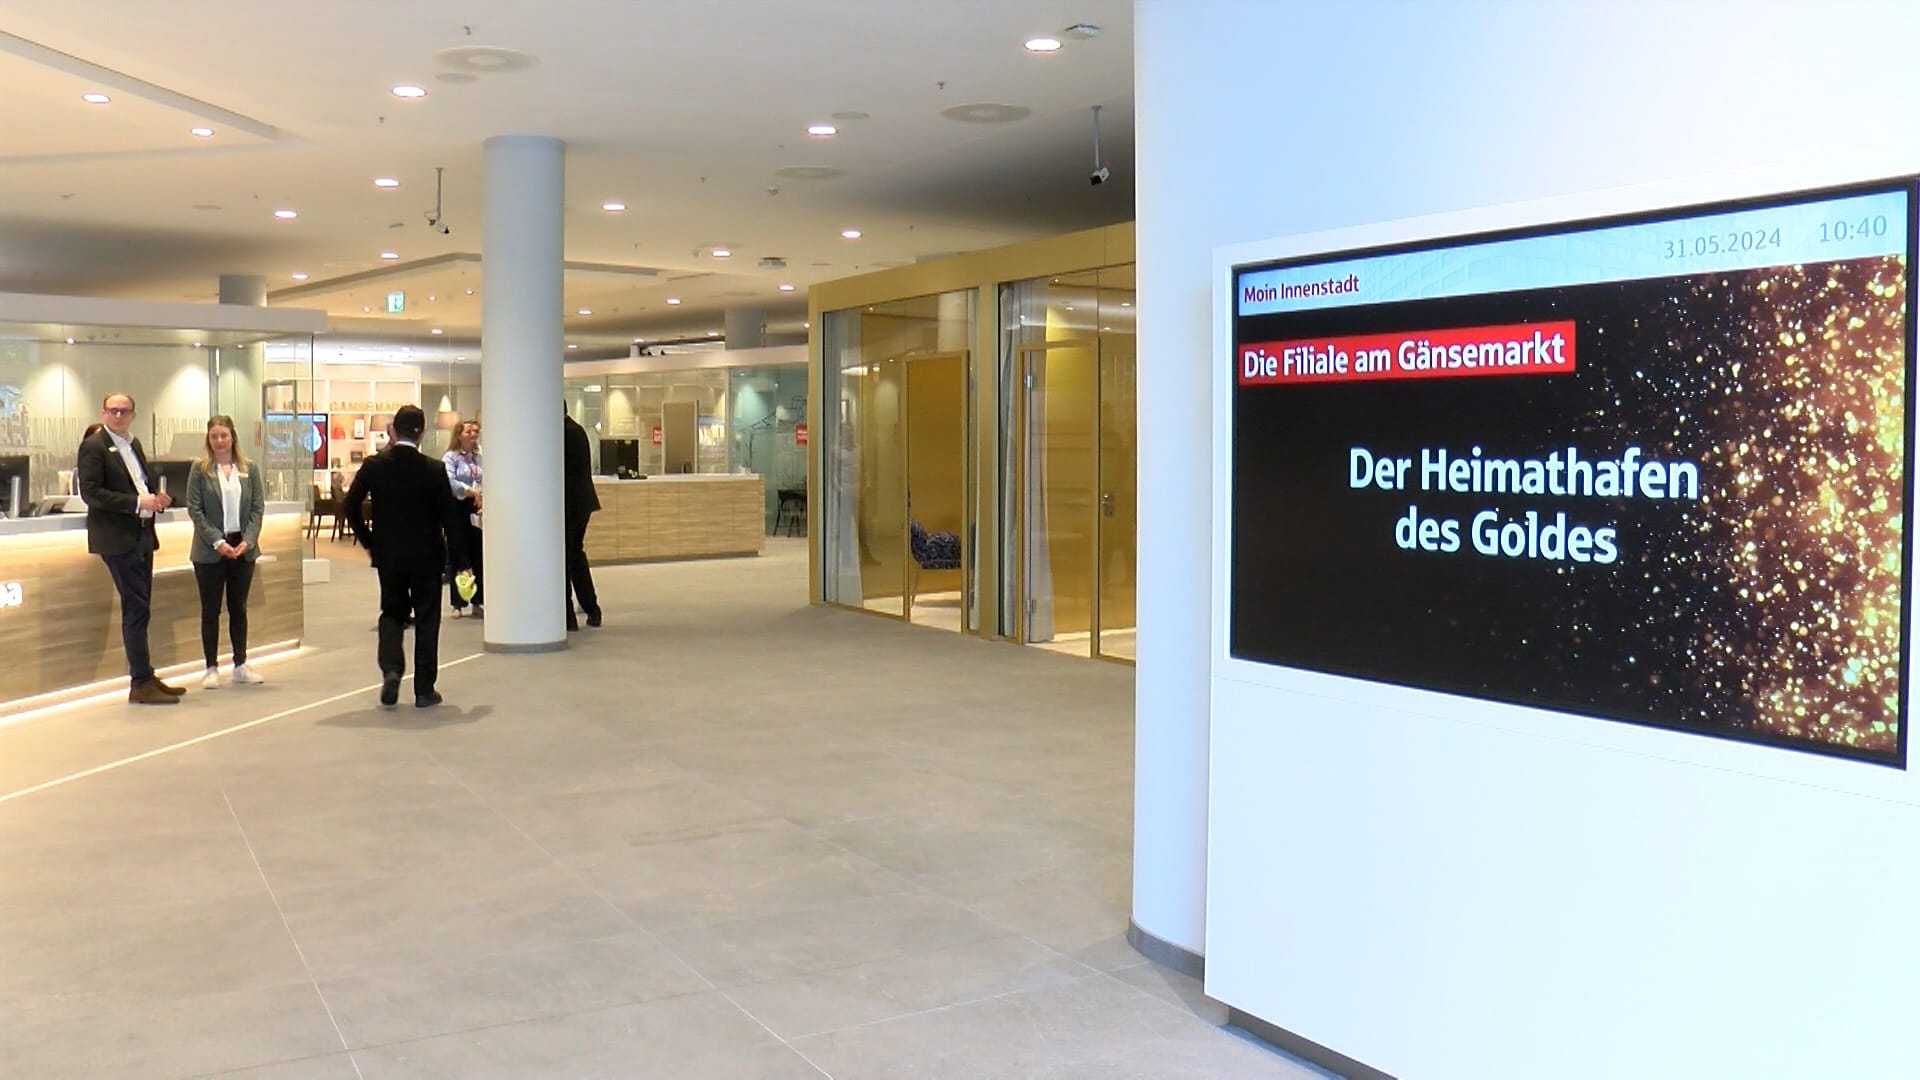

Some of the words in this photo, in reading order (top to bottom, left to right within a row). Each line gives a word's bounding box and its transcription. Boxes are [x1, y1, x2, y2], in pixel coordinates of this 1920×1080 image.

[1664, 228, 1781, 260] 31.05.2024
[1819, 215, 1888, 243] 10:40
[1244, 283, 1277, 303] Moin
[1281, 274, 1360, 300] Innenstadt
[1244, 349, 1277, 378] Die
[1283, 345, 1348, 376] Filiale
[1354, 347, 1391, 372] am
[1398, 331, 1566, 371] Gänsemarkt
[1349, 447, 1412, 490] Der
[1421, 445, 1699, 500] Heimathafen
[1395, 505, 1461, 553] des
[1471, 510, 1619, 564] Goldes
